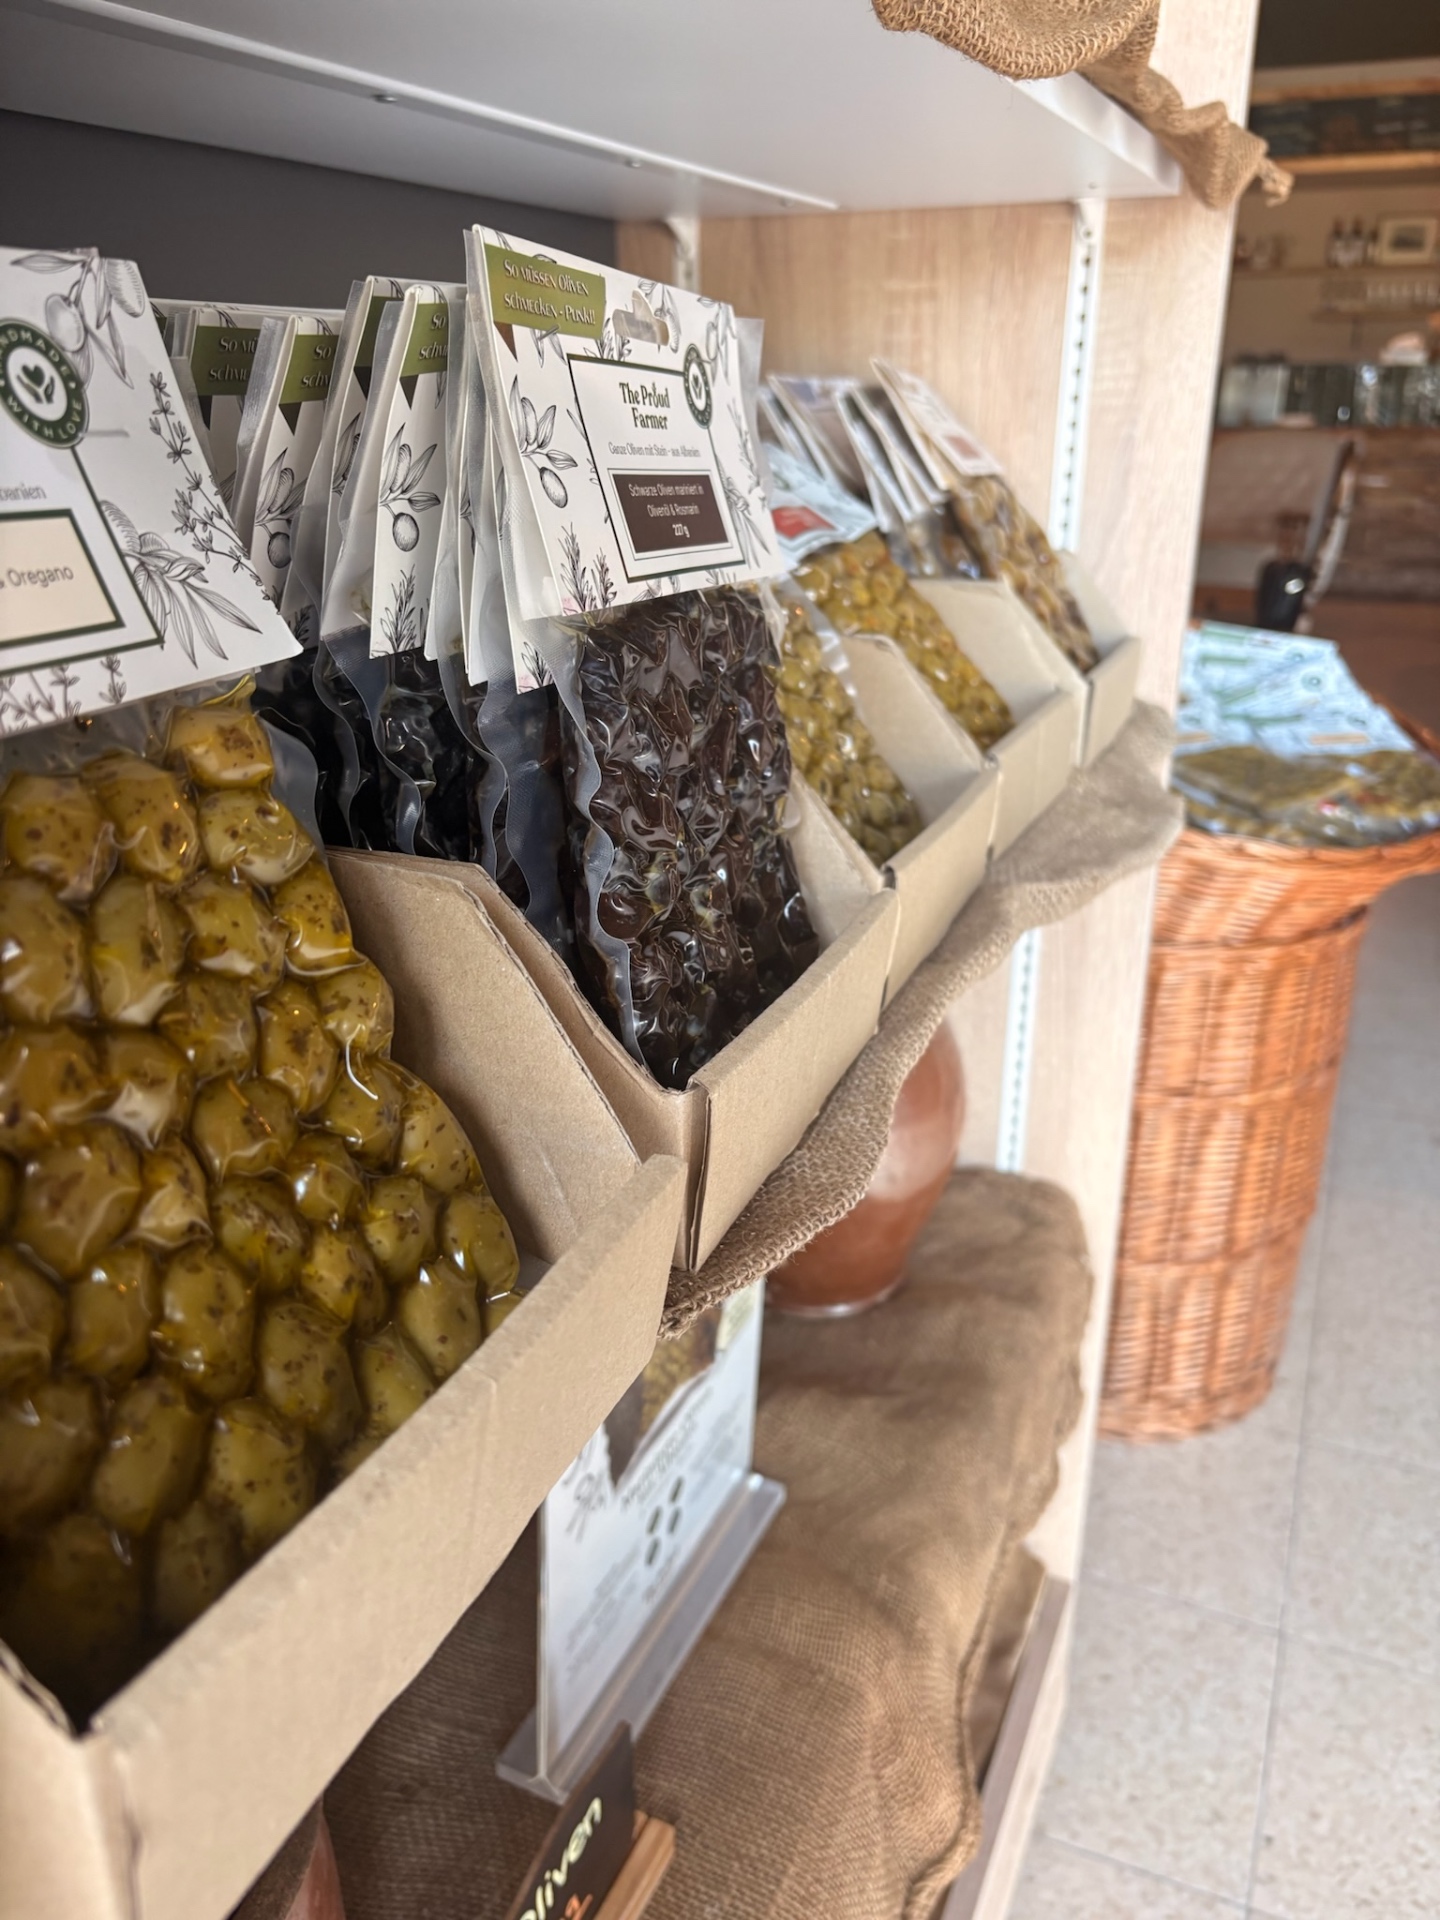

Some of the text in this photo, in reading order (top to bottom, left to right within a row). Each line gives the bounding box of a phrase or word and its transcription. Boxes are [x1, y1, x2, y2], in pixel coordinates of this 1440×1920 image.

[503, 259, 519, 278] So
[619, 382, 671, 409] The Proud
[631, 406, 669, 430] Farmer
[6, 567, 74, 588] Oregano
